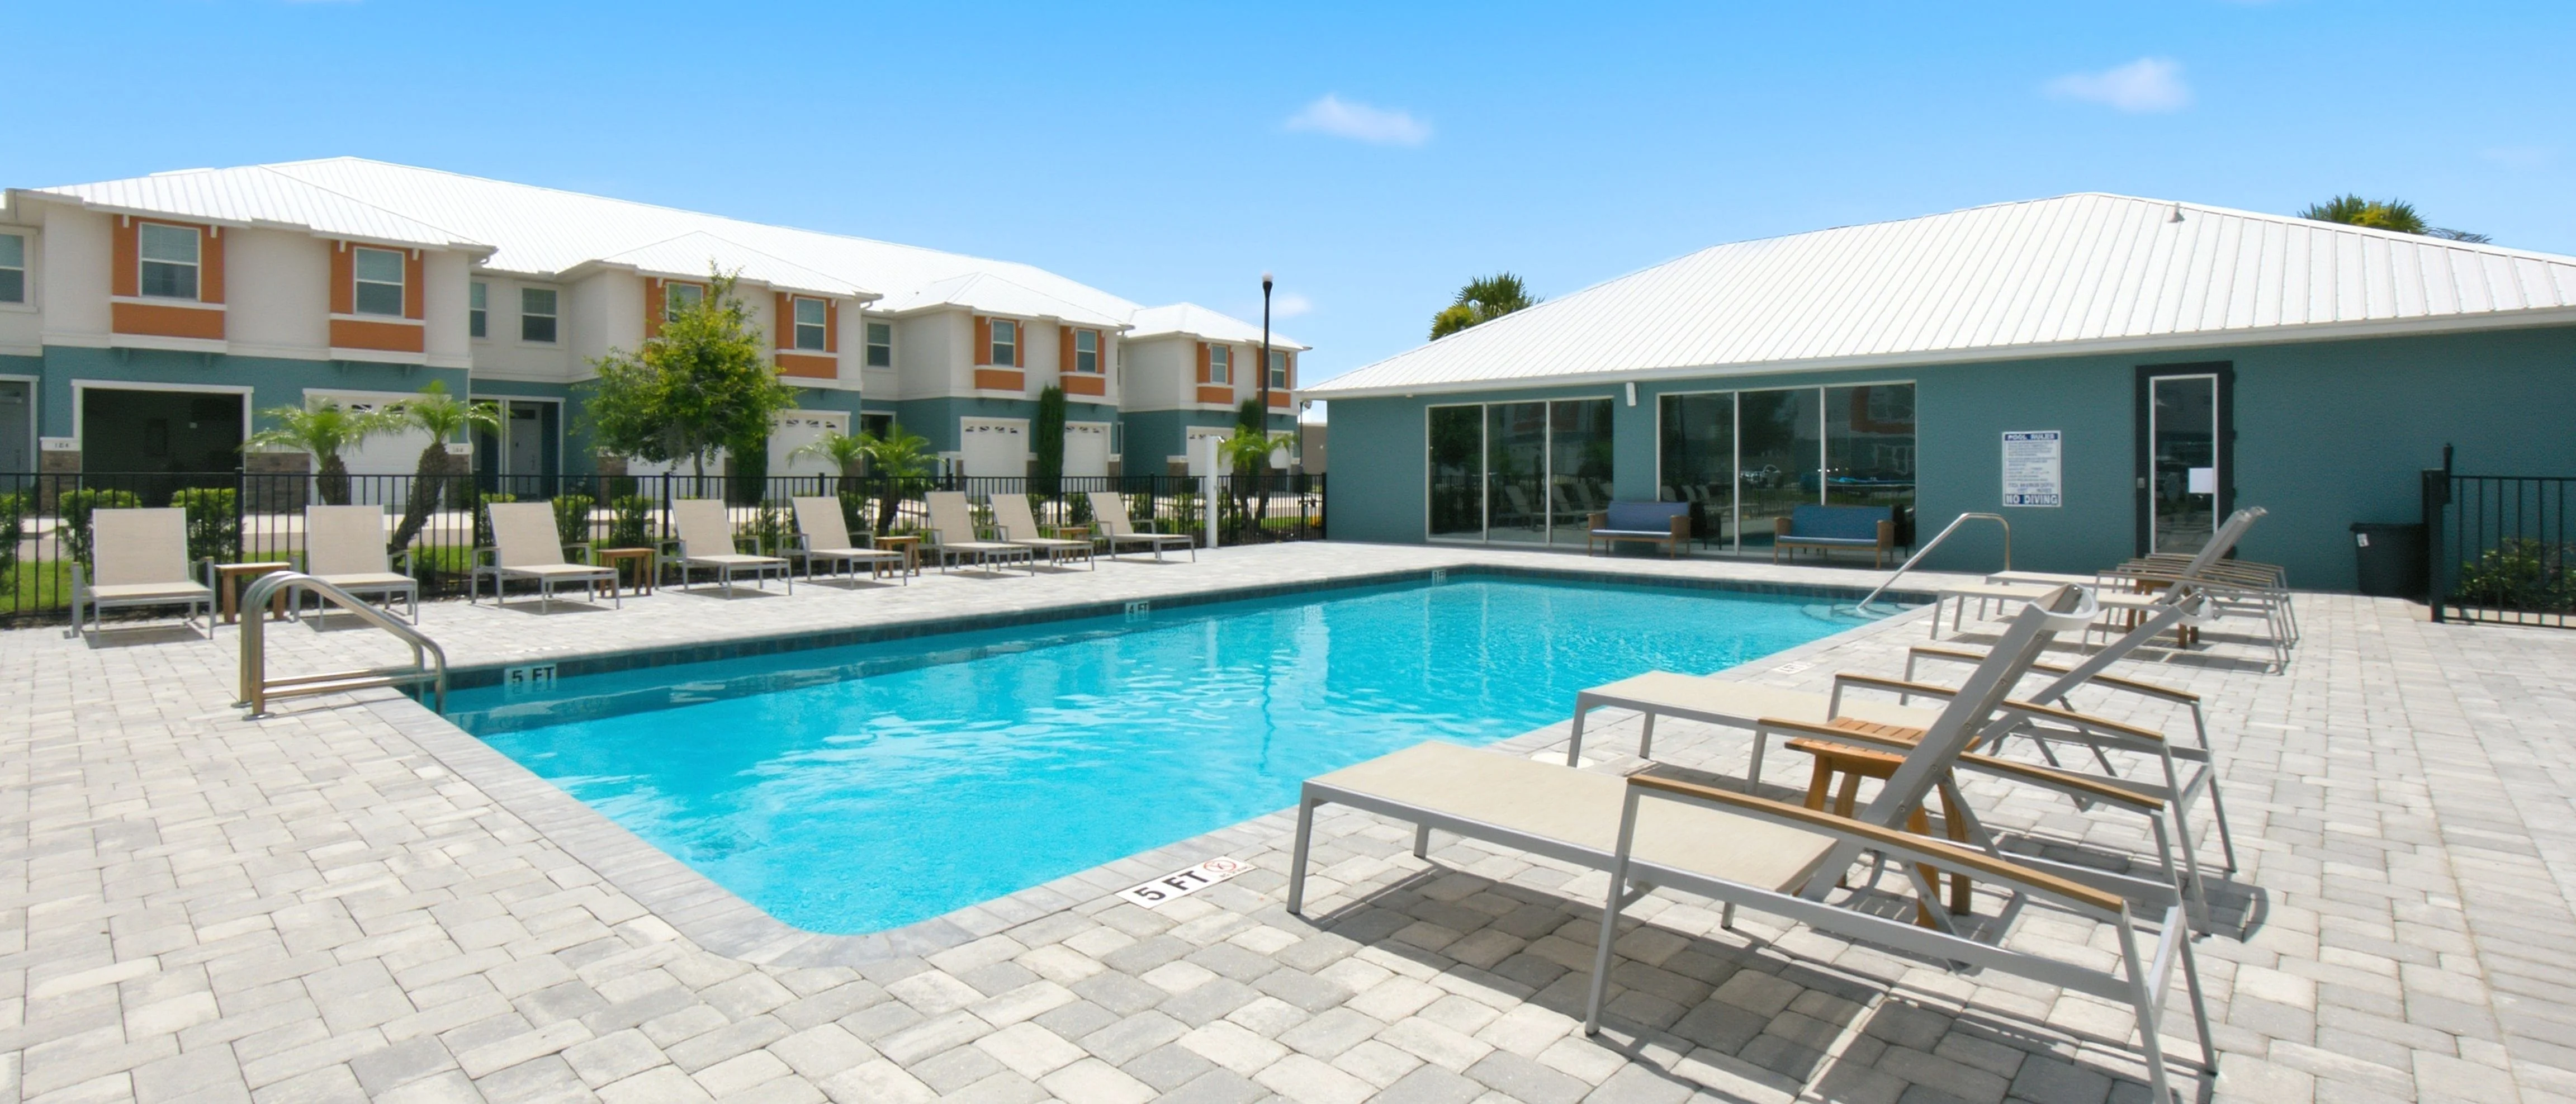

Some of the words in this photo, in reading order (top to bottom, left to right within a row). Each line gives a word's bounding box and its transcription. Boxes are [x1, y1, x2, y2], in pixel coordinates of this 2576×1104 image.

[2006, 495, 2020, 504] NO
[2024, 495, 2058, 504] DIVING
[512, 670, 523, 683] 5
[532, 666, 555, 681] FT
[1133, 887, 1166, 901] 5
[1162, 870, 1209, 891] FT
